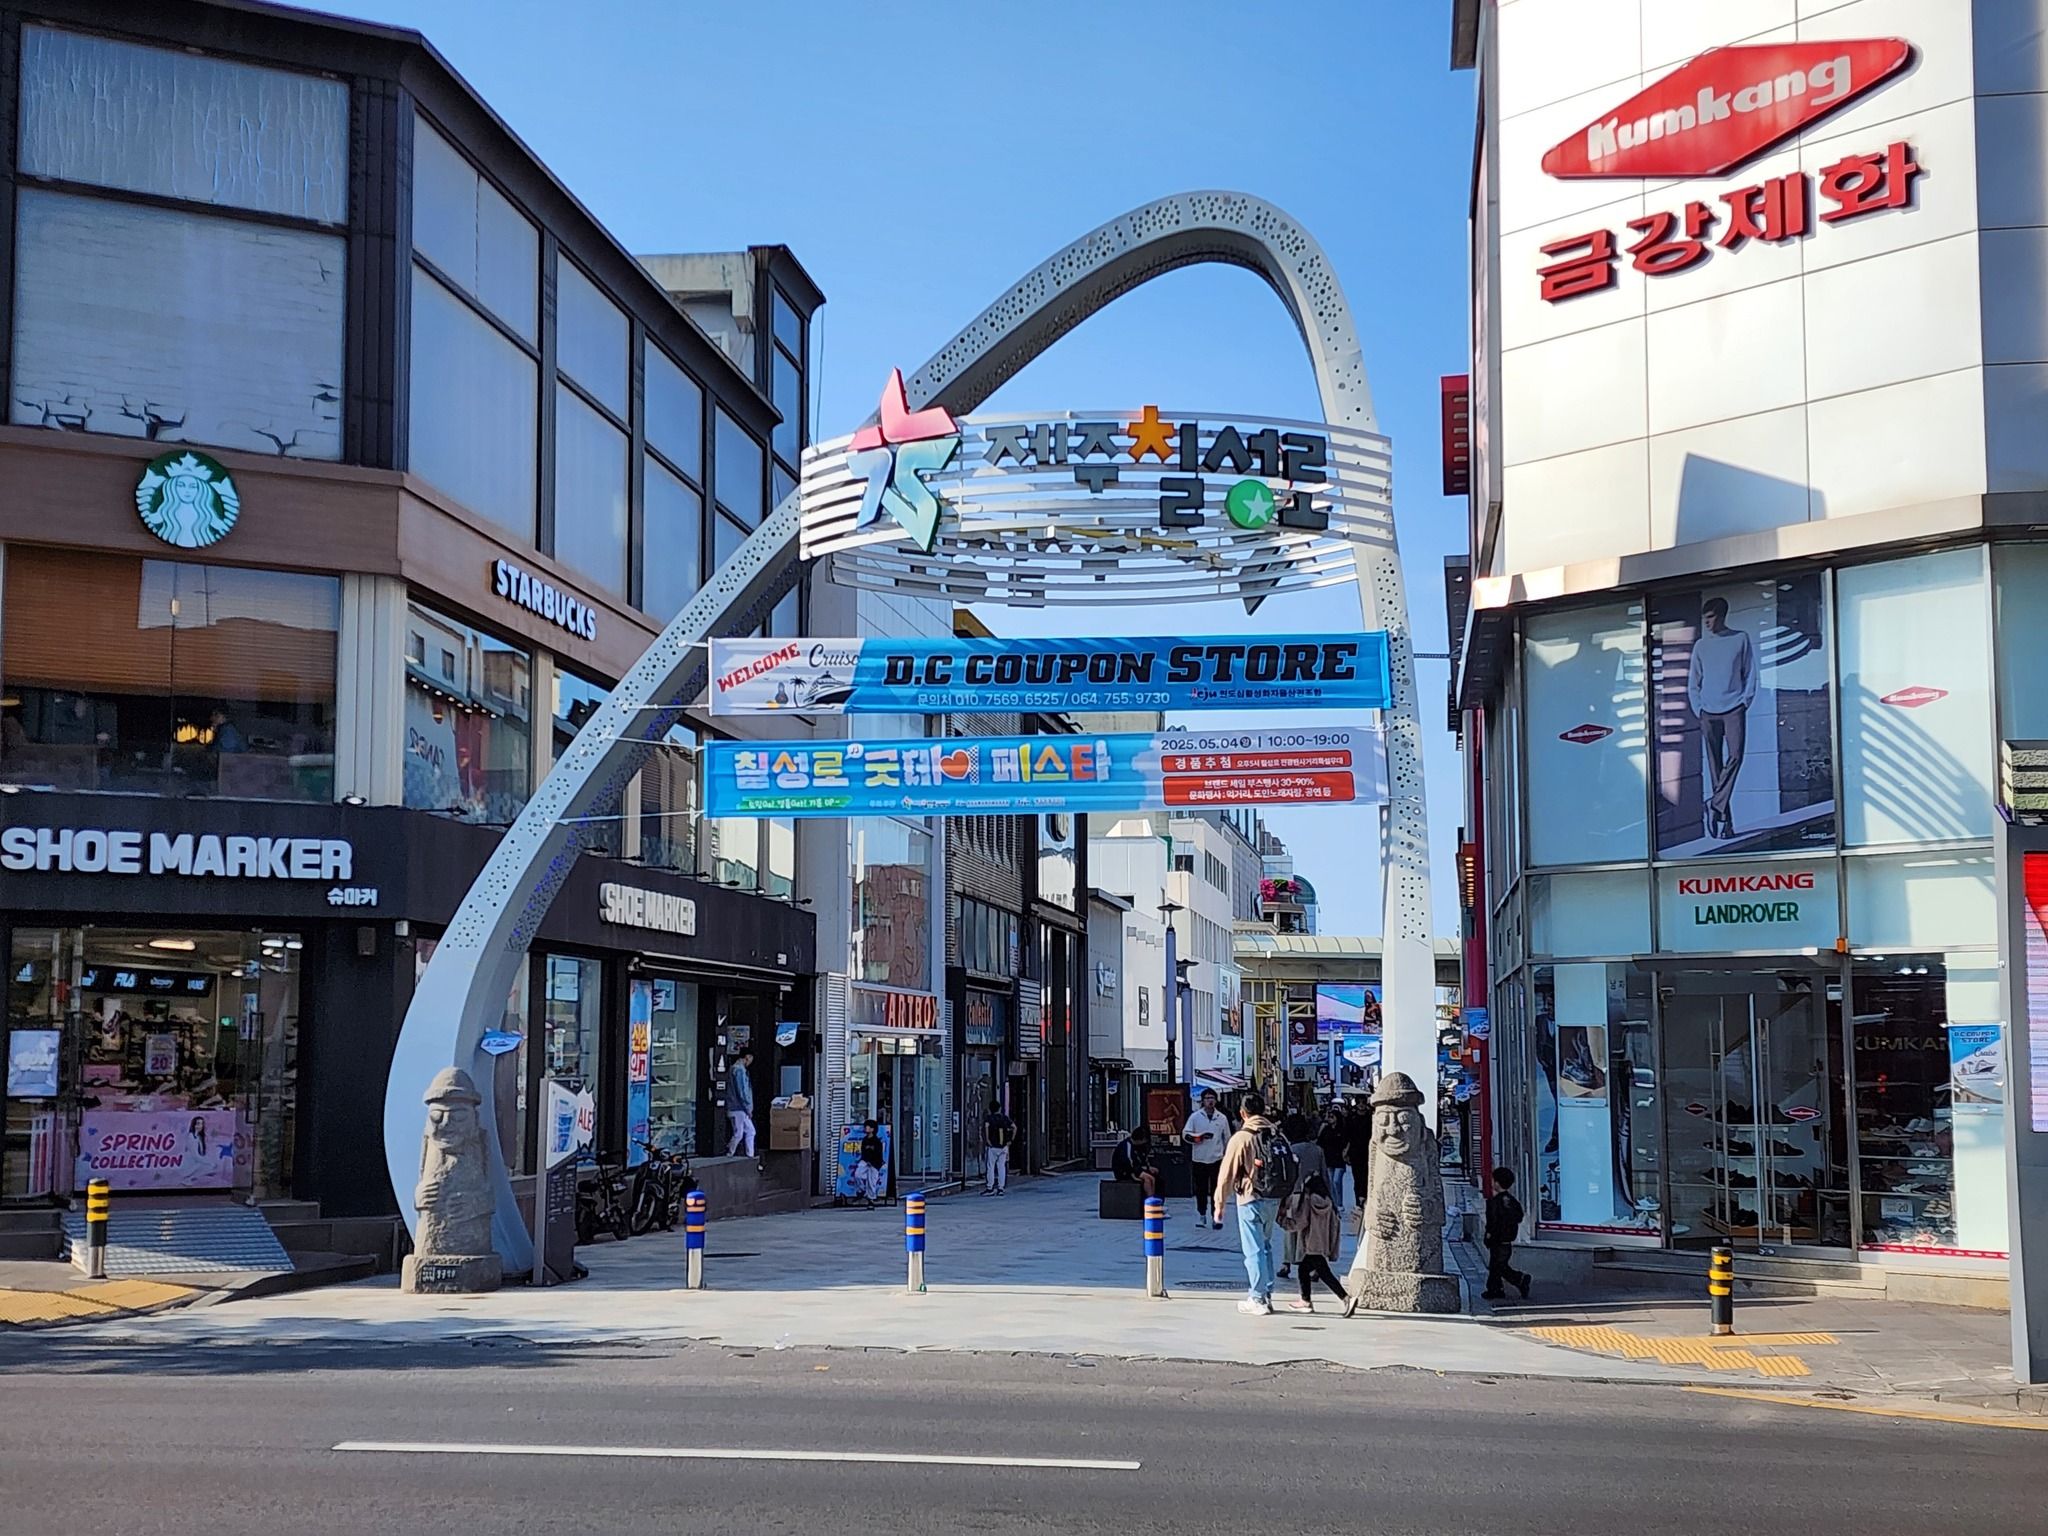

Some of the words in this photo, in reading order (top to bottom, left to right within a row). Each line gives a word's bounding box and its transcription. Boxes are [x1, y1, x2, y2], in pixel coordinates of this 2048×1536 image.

[1587, 54, 1853, 163] Kumkang
[1536, 141, 1919, 303] 금강제화
[492, 559, 597, 641] STARBUCKS
[716, 643, 801, 693] WELCOME
[883, 654, 953, 686] D.C
[965, 652, 1156, 686] COUPON
[1167, 643, 1358, 683] STORE
[918, 693, 952, 706] 문의처
[1025, 693, 1060, 705] 6525
[1135, 692, 1170, 704] 9730
[1268, 734, 1349, 747] 10:00~19:00
[734, 750, 850, 790] 칠성로
[991, 740, 1112, 783] 페스타
[1204, 779, 1229, 789] 브랜드
[1230, 778, 1246, 788] 세일
[1247, 778, 1279, 787] 부스행사
[1305, 787, 1322, 797] 공연
[1323, 787, 1331, 797] 등
[1, 827, 143, 875] SHOE
[149, 831, 352, 881] MARKER
[1678, 871, 1815, 896] KUMKANG
[326, 886, 379, 909] 슈마커
[600, 882, 644, 927] SHOE
[645, 891, 697, 936] MARKER
[1694, 902, 1800, 926] LANDROVER
[577, 1106, 593, 1132] ALE
[99, 1133, 176, 1153] SPRING
[90, 1153, 184, 1170] COLLECTION
